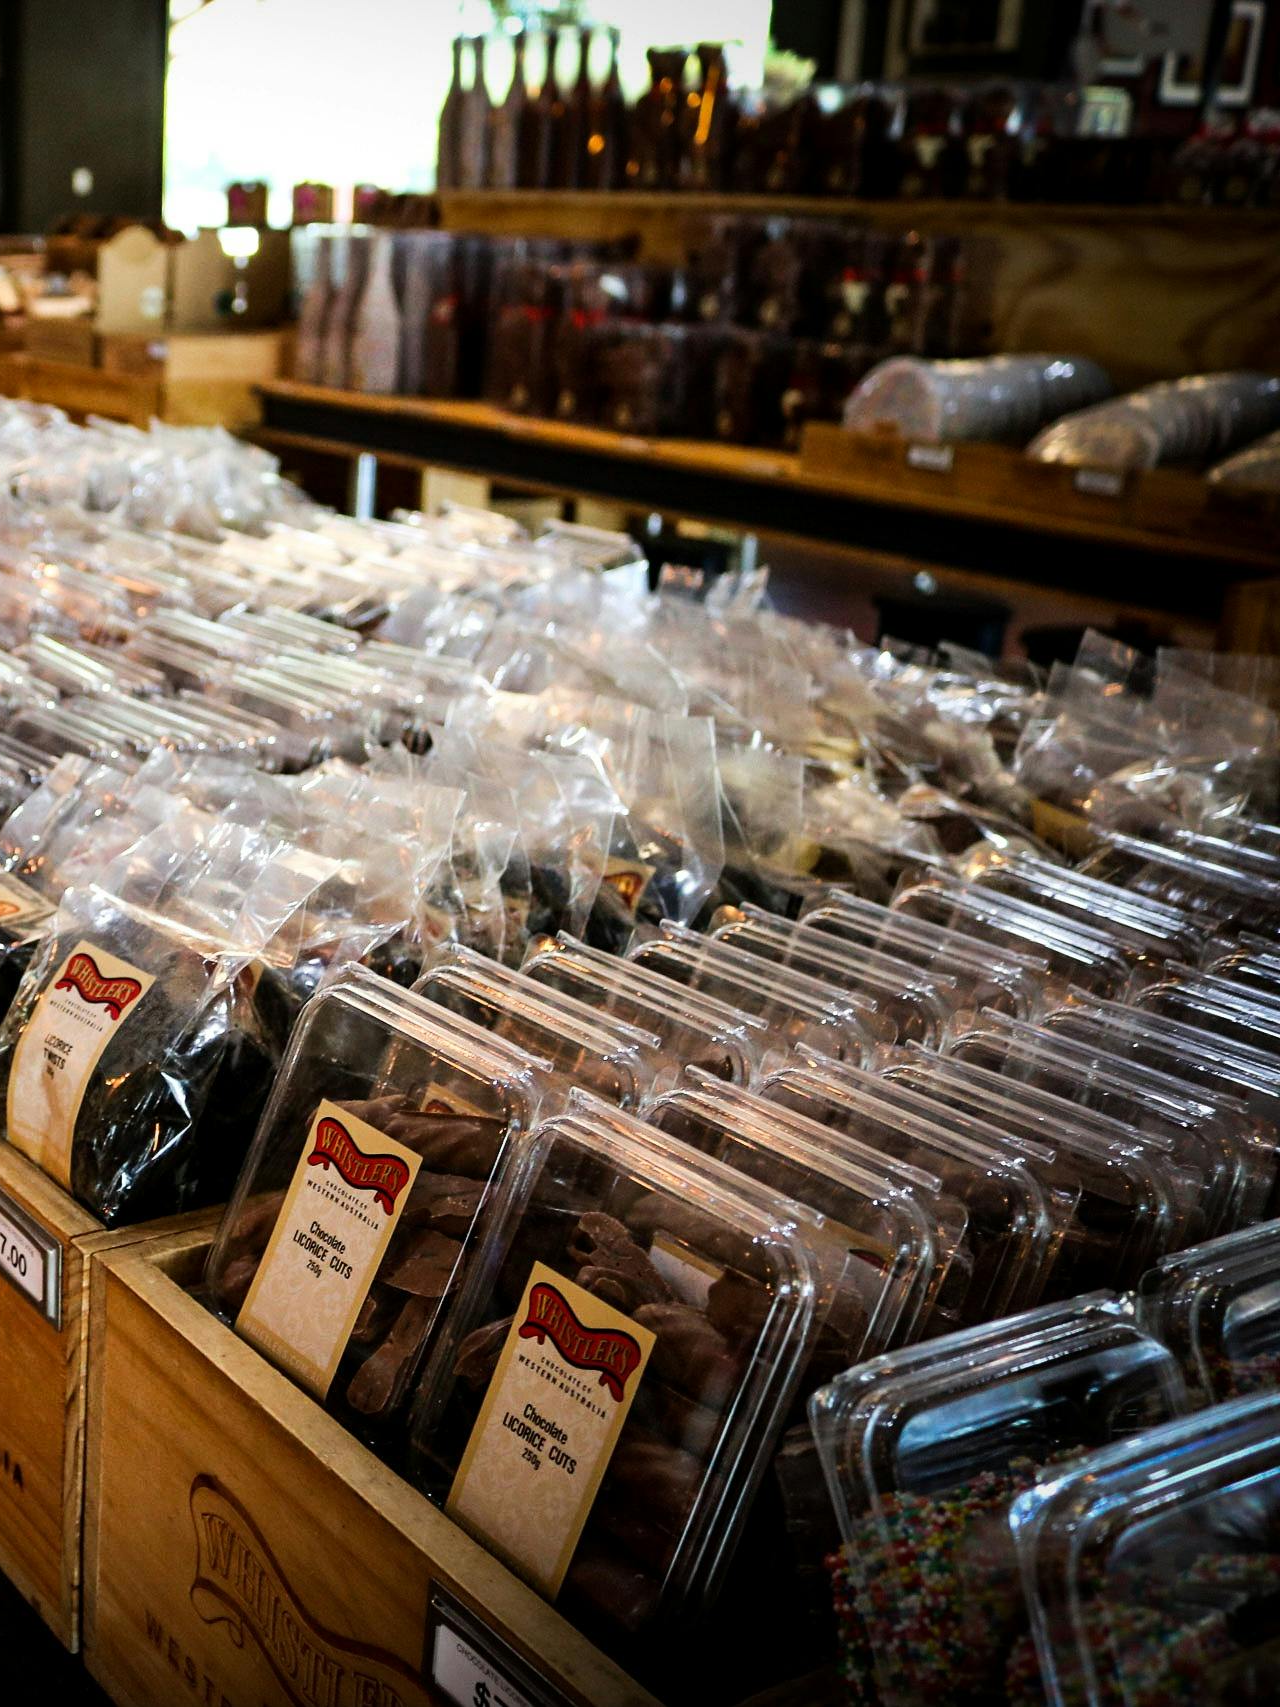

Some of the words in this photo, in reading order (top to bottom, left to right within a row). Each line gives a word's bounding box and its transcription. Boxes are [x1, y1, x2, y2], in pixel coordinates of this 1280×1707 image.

[43, 1047, 66, 1070] TWISTS
[44, 1033, 73, 1056] LICORICE
[322, 1126, 402, 1192] WHISTLER'S
[307, 1179, 339, 1203] WESTERN
[340, 1201, 379, 1230] AUSTRALIA
[325, 1180, 360, 1205] CHOCOLATE
[293, 1229, 328, 1261] LICORICE
[329, 1255, 353, 1280] CUTS
[309, 1220, 346, 1255] Chocolate
[306, 1259, 322, 1278] 250g
[536, 1293, 631, 1374] WHISTLER'S
[518, 1354, 558, 1385] WESTERN
[559, 1381, 607, 1419] AUSTRALIA
[540, 1356, 581, 1388] CHOCOLATE
[502, 1411, 546, 1452] LICORICE
[548, 1445, 577, 1475] CUTS
[523, 1403, 568, 1445] Chocolate
[521, 1447, 541, 1471] 250g
